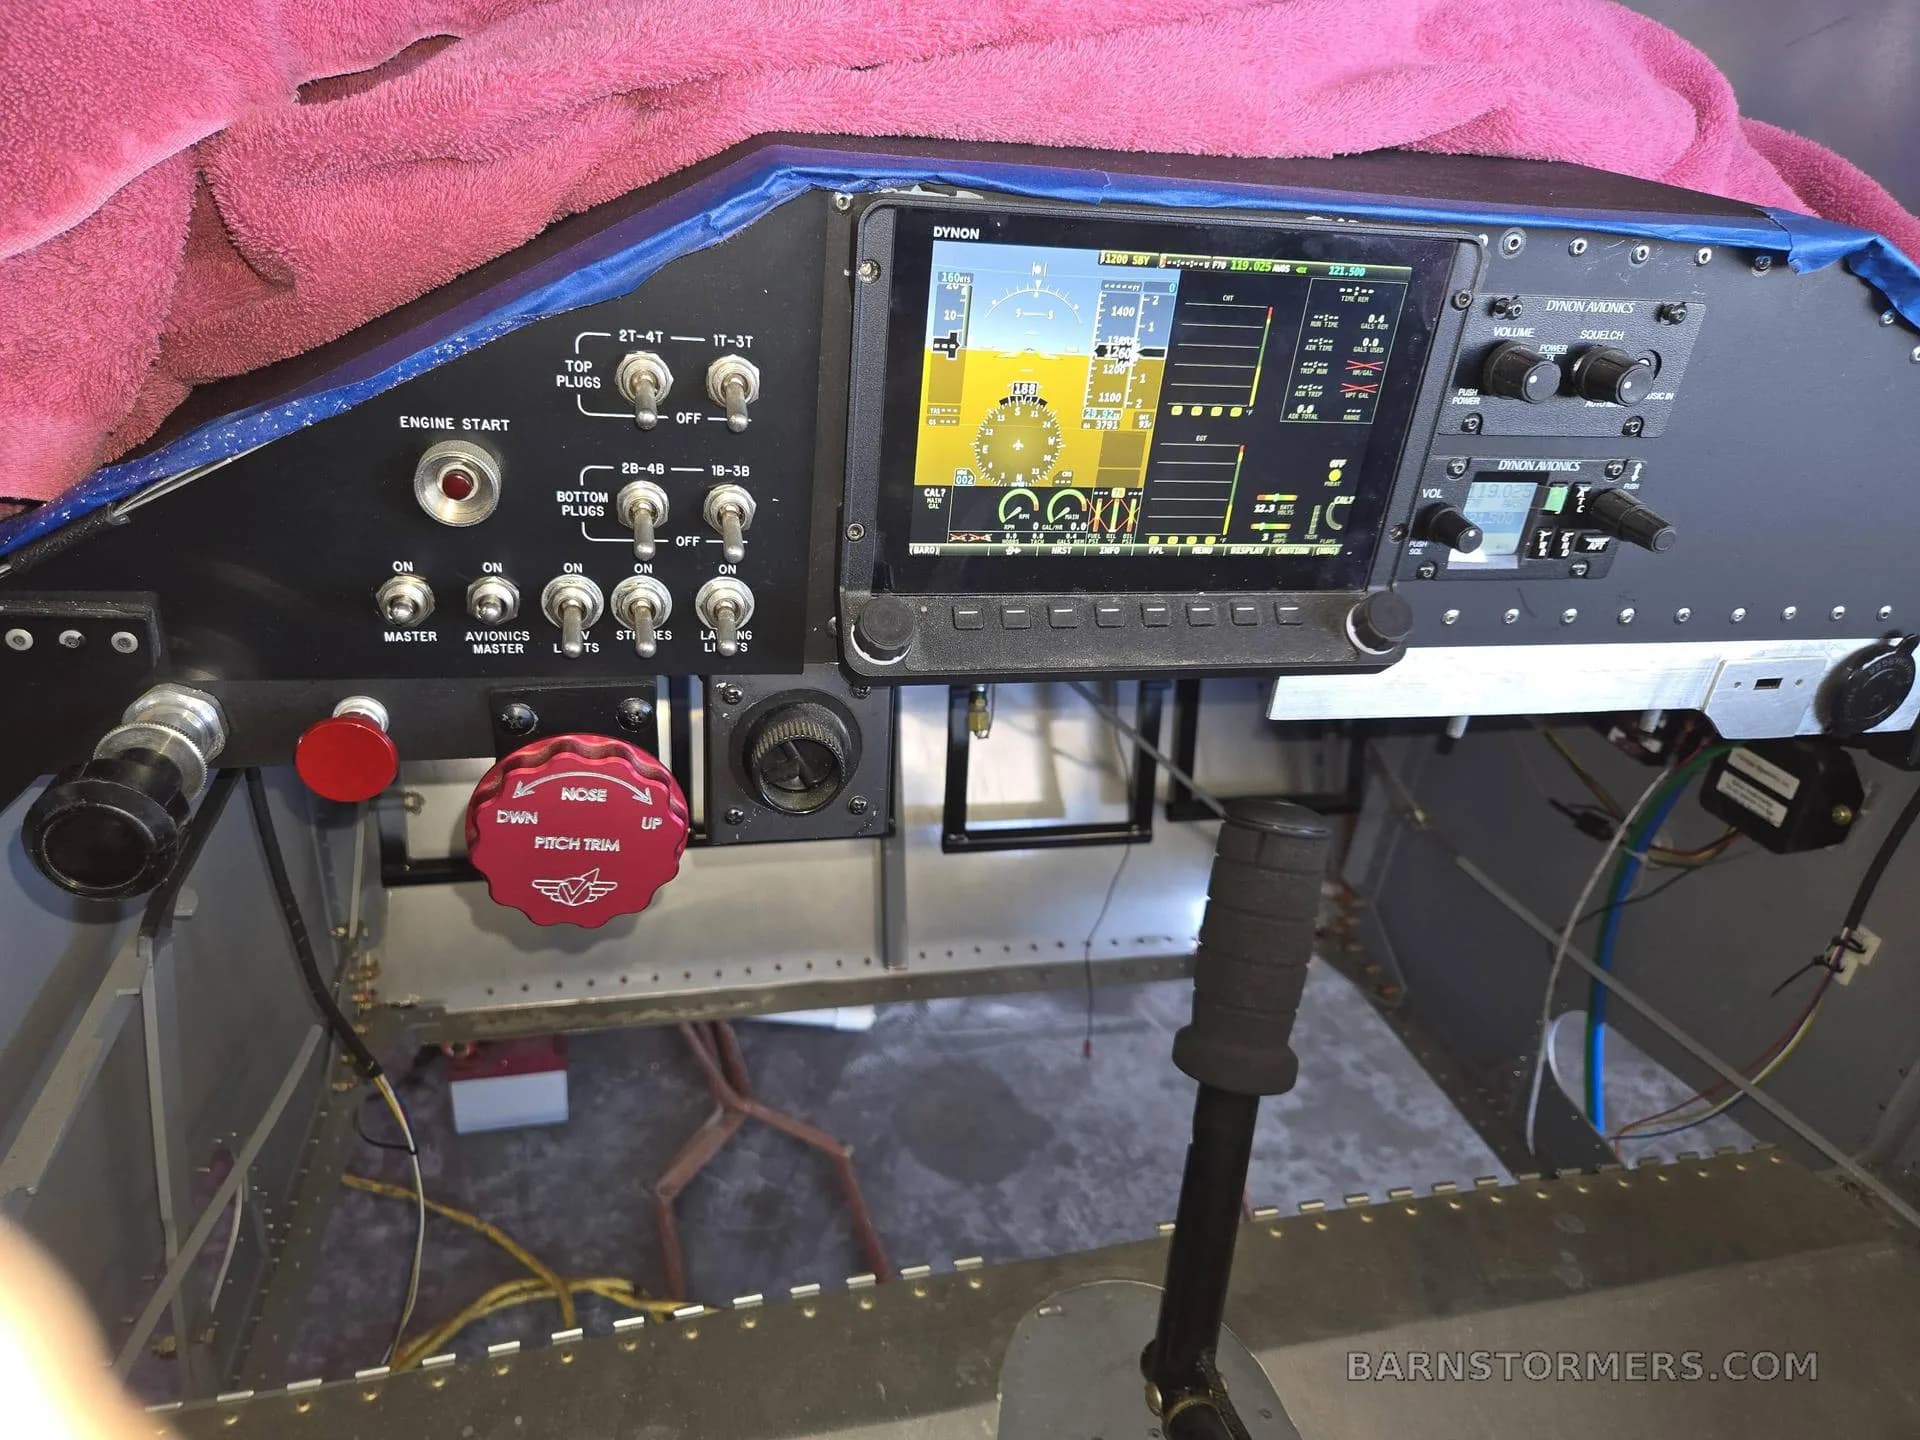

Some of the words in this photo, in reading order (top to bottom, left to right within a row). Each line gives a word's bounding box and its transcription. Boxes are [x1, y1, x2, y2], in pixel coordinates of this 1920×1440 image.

[933, 226, 980, 240] DYNON
[1105, 254, 1128, 264] 1200
[1132, 256, 1150, 265] SBY
[1230, 260, 1272, 272] 119.025
[1328, 265, 1365, 276] 121.500
[1152, 296, 1159, 305] 2
[1111, 306, 1135, 316] 1400
[1546, 300, 1584, 312] DYNON
[1586, 301, 1634, 314] AVIONICS
[944, 310, 957, 320] 10
[1148, 322, 1154, 332] 1
[1494, 327, 1535, 338] VOLUME
[618, 330, 664, 344] 2T-4T
[713, 334, 754, 348] 1T-3T
[1580, 330, 1624, 340] SQUELCH
[1540, 344, 1568, 352] POWER
[564, 360, 594, 373] TOP
[556, 374, 601, 390] PLUGS
[1140, 374, 1146, 383] 1
[1098, 392, 1122, 402] 1100
[1452, 396, 1480, 405] POWER
[1135, 399, 1143, 408] 2
[400, 416, 456, 430] ENGINE
[462, 418, 510, 432] START
[676, 412, 702, 425] OFF
[621, 462, 666, 476] 2B-4B
[711, 464, 750, 478] 1B-3B
[1498, 460, 1534, 471] DYNON
[1535, 461, 1581, 472] AVIONICS
[956, 476, 973, 484] 002
[556, 490, 609, 504] BOTTOM
[924, 488, 946, 497] CAL?
[1422, 489, 1442, 498] VOL
[561, 504, 606, 518] PLUGS
[675, 534, 700, 548] OFF
[392, 560, 414, 573] ON
[482, 562, 502, 574] ON
[563, 562, 583, 574] ON
[634, 562, 653, 574] ON
[718, 563, 737, 575] ON
[384, 630, 438, 643] MASTER
[464, 630, 530, 642] AVIONICS
[616, 630, 672, 640] STES
[700, 630, 752, 640] LANG
[473, 643, 524, 654] MASTER
[553, 642, 600, 653] LTS
[561, 787, 608, 802] NOSE
[496, 810, 538, 824] DWN
[641, 817, 663, 830] UP
[534, 836, 580, 850] PITCH
[583, 838, 620, 852] TRIM
